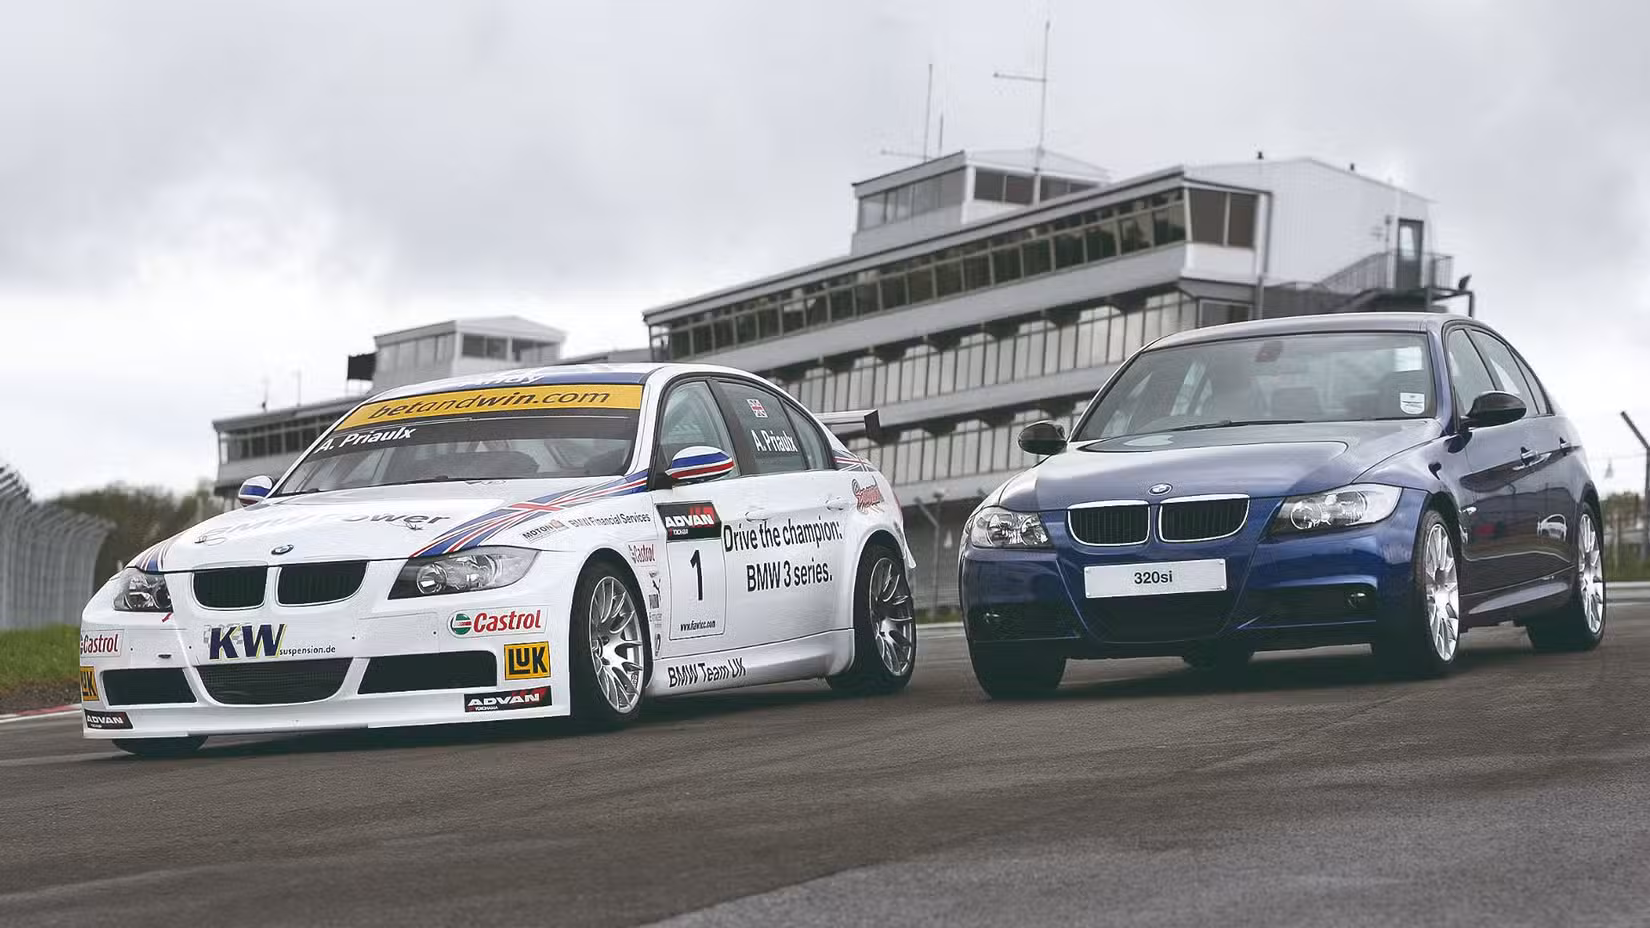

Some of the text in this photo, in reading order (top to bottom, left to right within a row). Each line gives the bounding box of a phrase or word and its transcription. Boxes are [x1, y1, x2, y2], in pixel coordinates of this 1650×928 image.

[368, 390, 610, 419] betandwin.com
[313, 426, 417, 454] A. Priaulx
[620, 511, 651, 525] Services
[665, 514, 714, 528] ADVAN
[724, 514, 843, 552] Drive the champion:
[690, 549, 703, 601] 1
[746, 557, 833, 592] BMW 3 series.
[1134, 569, 1173, 586] 320si
[474, 609, 541, 633] Castrol
[83, 634, 118, 654] Castrol
[209, 623, 336, 660] KW suspension.de
[668, 657, 746, 688] BMW Team UK
[467, 693, 540, 706] ADVAN
[87, 715, 124, 724] ADVAN
